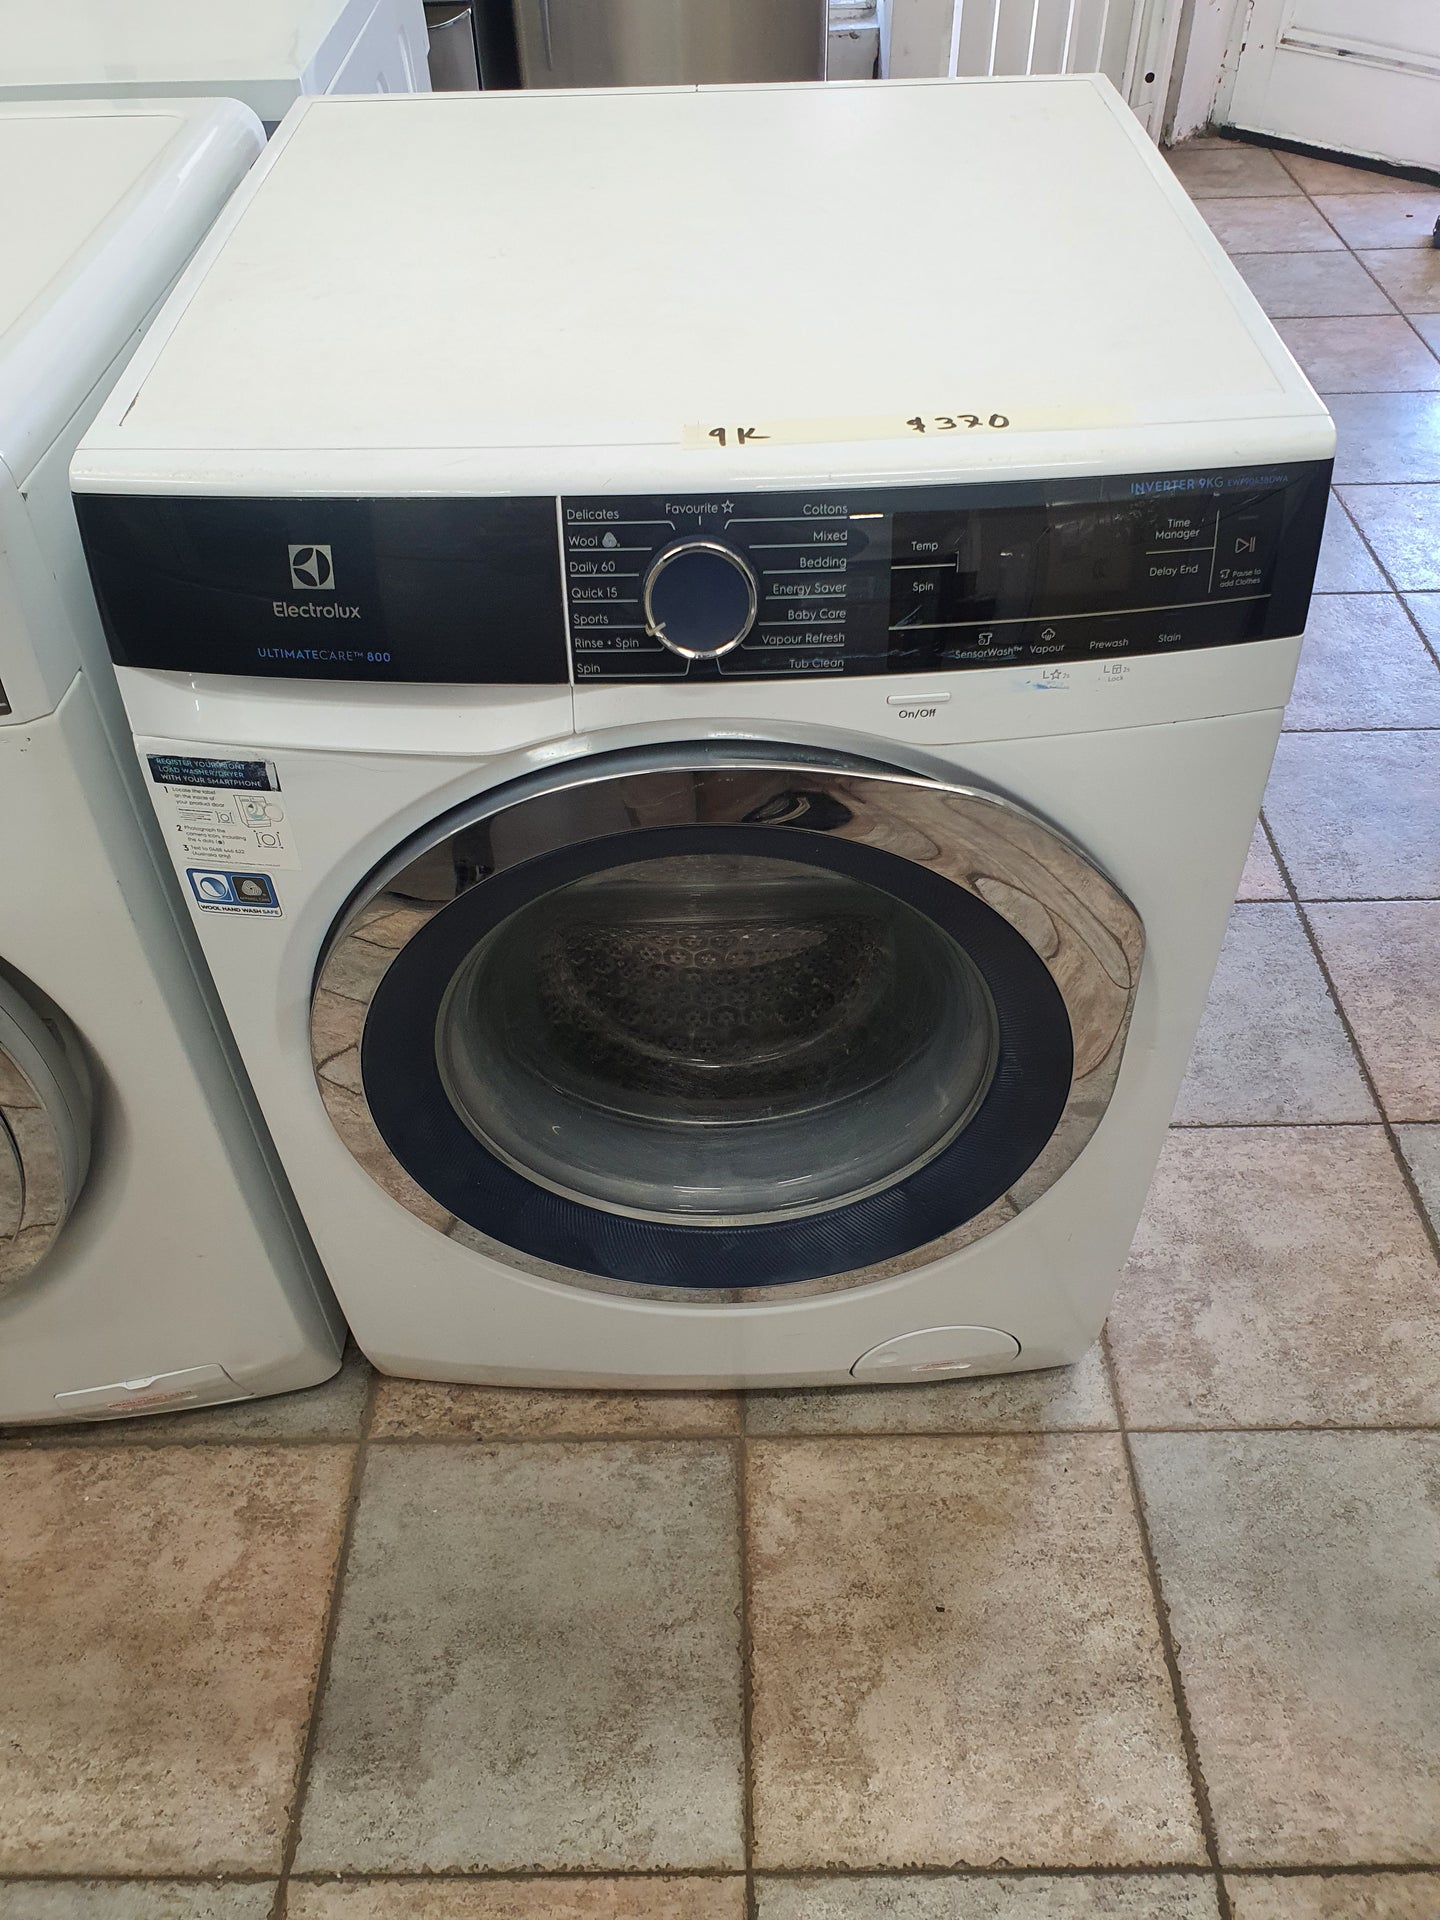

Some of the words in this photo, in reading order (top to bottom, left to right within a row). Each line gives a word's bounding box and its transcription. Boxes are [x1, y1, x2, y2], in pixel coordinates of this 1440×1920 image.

[1130, 479, 1194, 494] INVERTER
[1199, 476, 1224, 489] 9KG
[566, 509, 620, 520] Delicates
[665, 503, 719, 514] Favourite
[802, 504, 848, 515] Cottons
[1168, 518, 1191, 528] Time
[813, 530, 848, 542] Mixed
[1155, 528, 1200, 541] Manager
[568, 536, 598, 547] Wool
[911, 540, 939, 552] Temp
[569, 562, 598, 574] Daily
[601, 561, 616, 572] 60
[799, 557, 847, 570] Bedding
[1149, 565, 1177, 577] Delay
[1180, 564, 1199, 575] End
[571, 587, 603, 599] Quick
[606, 587, 618, 598] 15
[772, 583, 811, 596] Energy
[814, 582, 847, 594] Saver
[912, 581, 934, 593] Spin
[273, 601, 361, 619] Electrolux
[787, 609, 817, 621] Baby
[819, 608, 846, 619] Care
[573, 613, 609, 625] Sports
[574, 638, 604, 648] Rinse
[615, 638, 640, 650] Spin
[762, 634, 802, 646] Vapour
[805, 632, 845, 644] Refresh
[1089, 638, 1129, 650] Prewash
[1158, 633, 1181, 643] Stain
[1029, 643, 1065, 655] Vapour
[366, 652, 391, 662] 800
[576, 663, 601, 675] Spin
[789, 659, 809, 669] Tub
[812, 658, 845, 669] Clean
[898, 708, 937, 719] On/Off
[156, 758, 193, 768] REGISTER
[158, 766, 180, 774] LOAD
[161, 773, 182, 781] WITH
[183, 775, 206, 784] YOUR
[208, 778, 262, 788] SMARTPHONE
